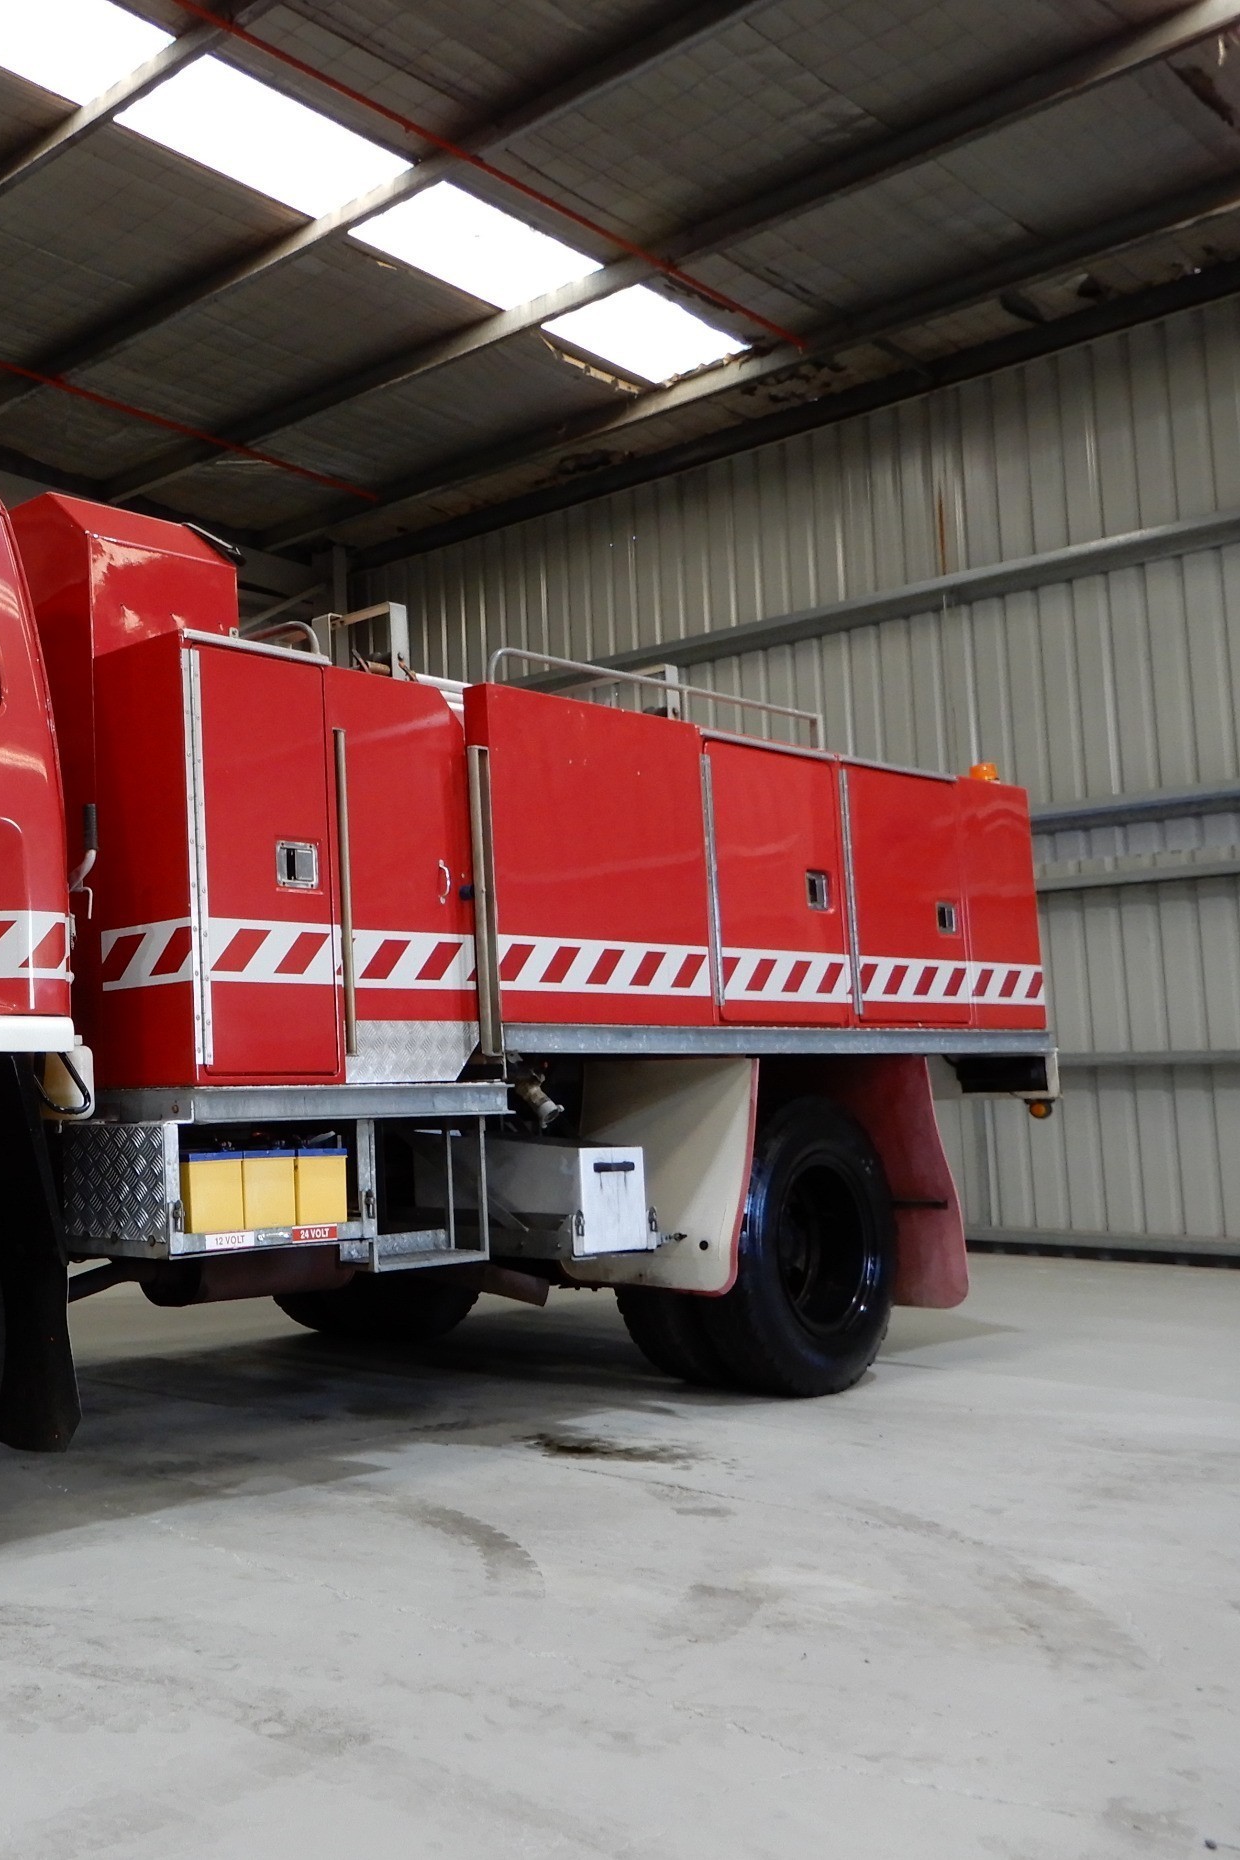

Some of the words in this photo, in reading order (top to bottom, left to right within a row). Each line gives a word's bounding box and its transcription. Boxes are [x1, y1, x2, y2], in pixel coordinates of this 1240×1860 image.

[300, 1229, 310, 1240] 24
[310, 1227, 330, 1239] VOLT
[215, 1236, 224, 1246] 12
[225, 1234, 246, 1245] VOLT
